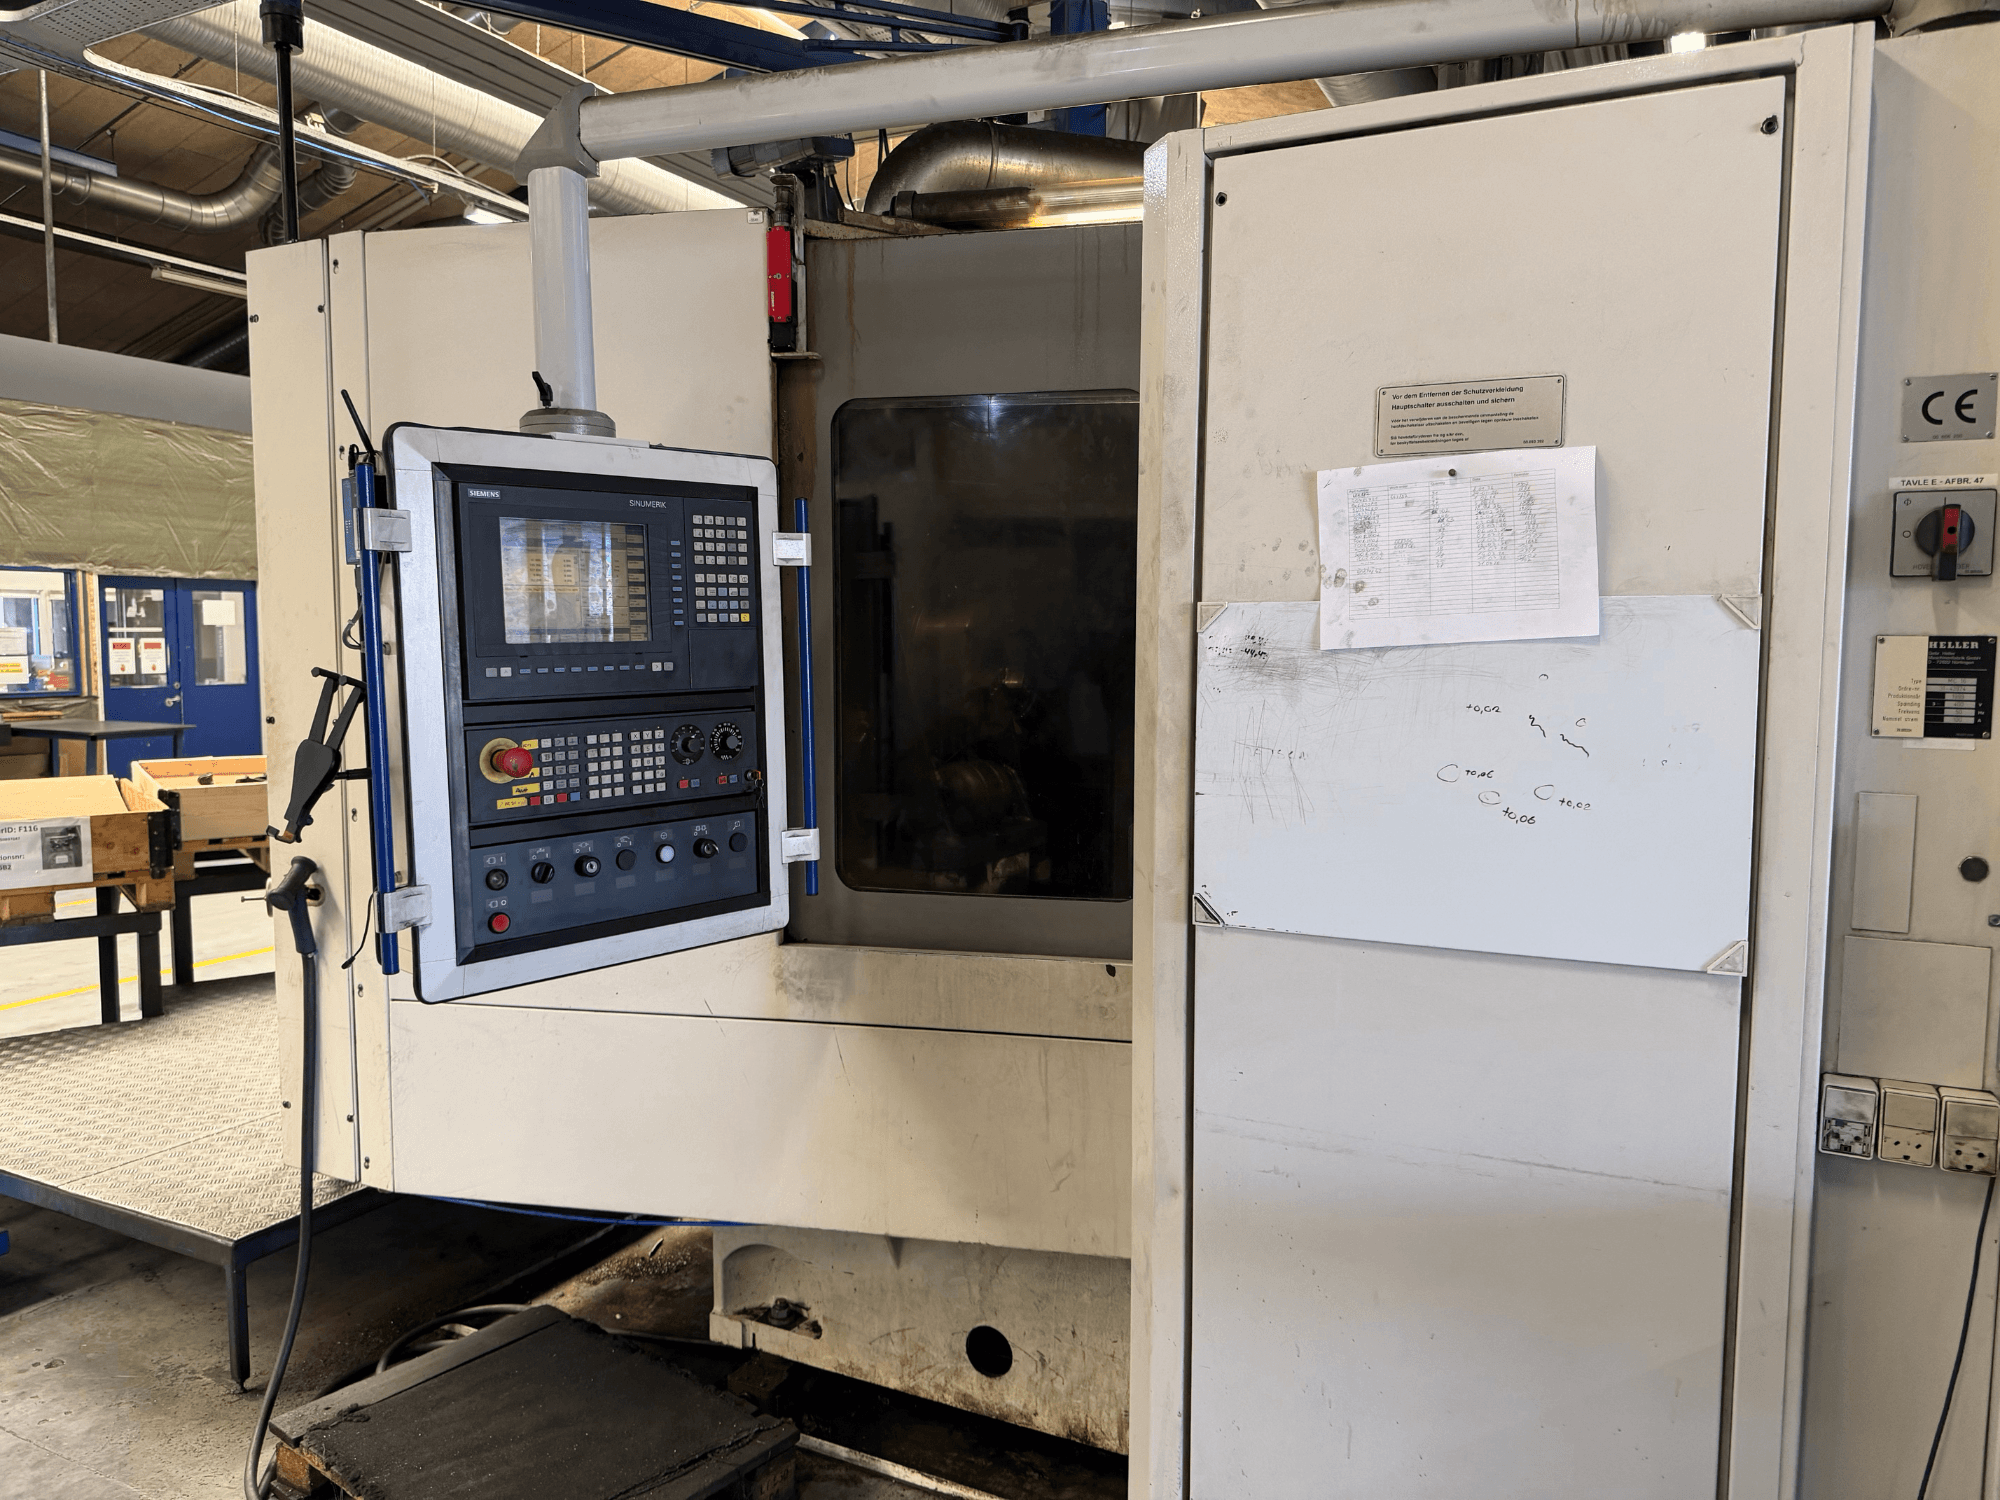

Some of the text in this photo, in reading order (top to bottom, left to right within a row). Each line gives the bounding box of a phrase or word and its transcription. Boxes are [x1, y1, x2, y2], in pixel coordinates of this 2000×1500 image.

[1463, 386, 1524, 395] Schutzverkleidung
[1391, 402, 1435, 411] Hauptschalter
[1436, 400, 1475, 408] ausschalten
[1921, 388, 1979, 426] CE
[1900, 479, 1929, 487] TAVLE
[1931, 478, 1938, 486] E
[1944, 477, 1972, 486] AFBR.
[1973, 477, 1985, 485] 47
[468, 489, 500, 499] SIEMENS
[629, 499, 667, 509] SINUMERIK
[1928, 641, 1979, 649] HELLER
[18, 825, 39, 833] F116
